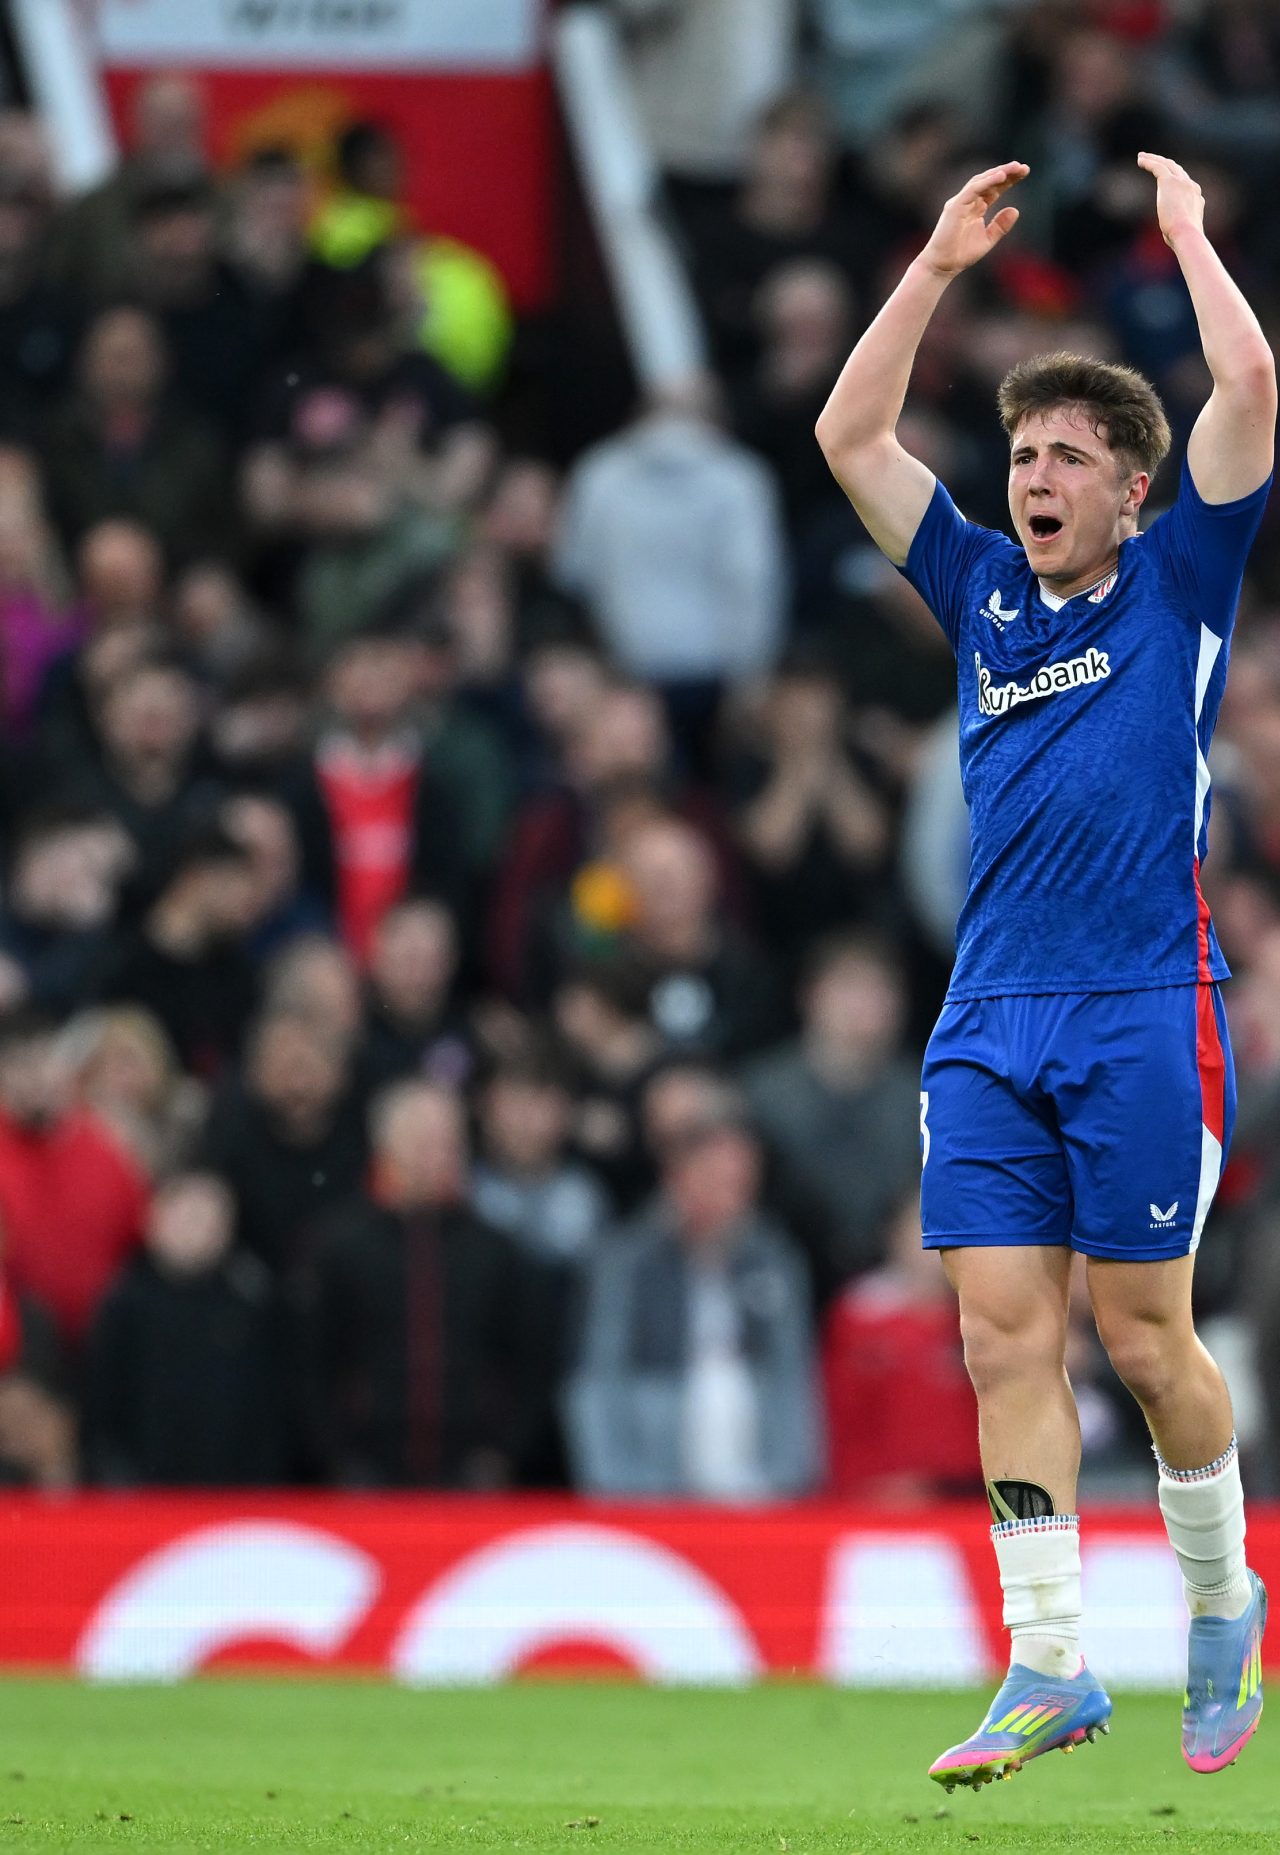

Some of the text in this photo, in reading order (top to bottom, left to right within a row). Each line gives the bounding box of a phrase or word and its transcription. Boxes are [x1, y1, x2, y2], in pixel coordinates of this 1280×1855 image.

[978, 608, 1006, 632] CASTORE
[975, 650, 1110, 713] Kutbank
[1149, 1221, 1176, 1229] CASTORE
